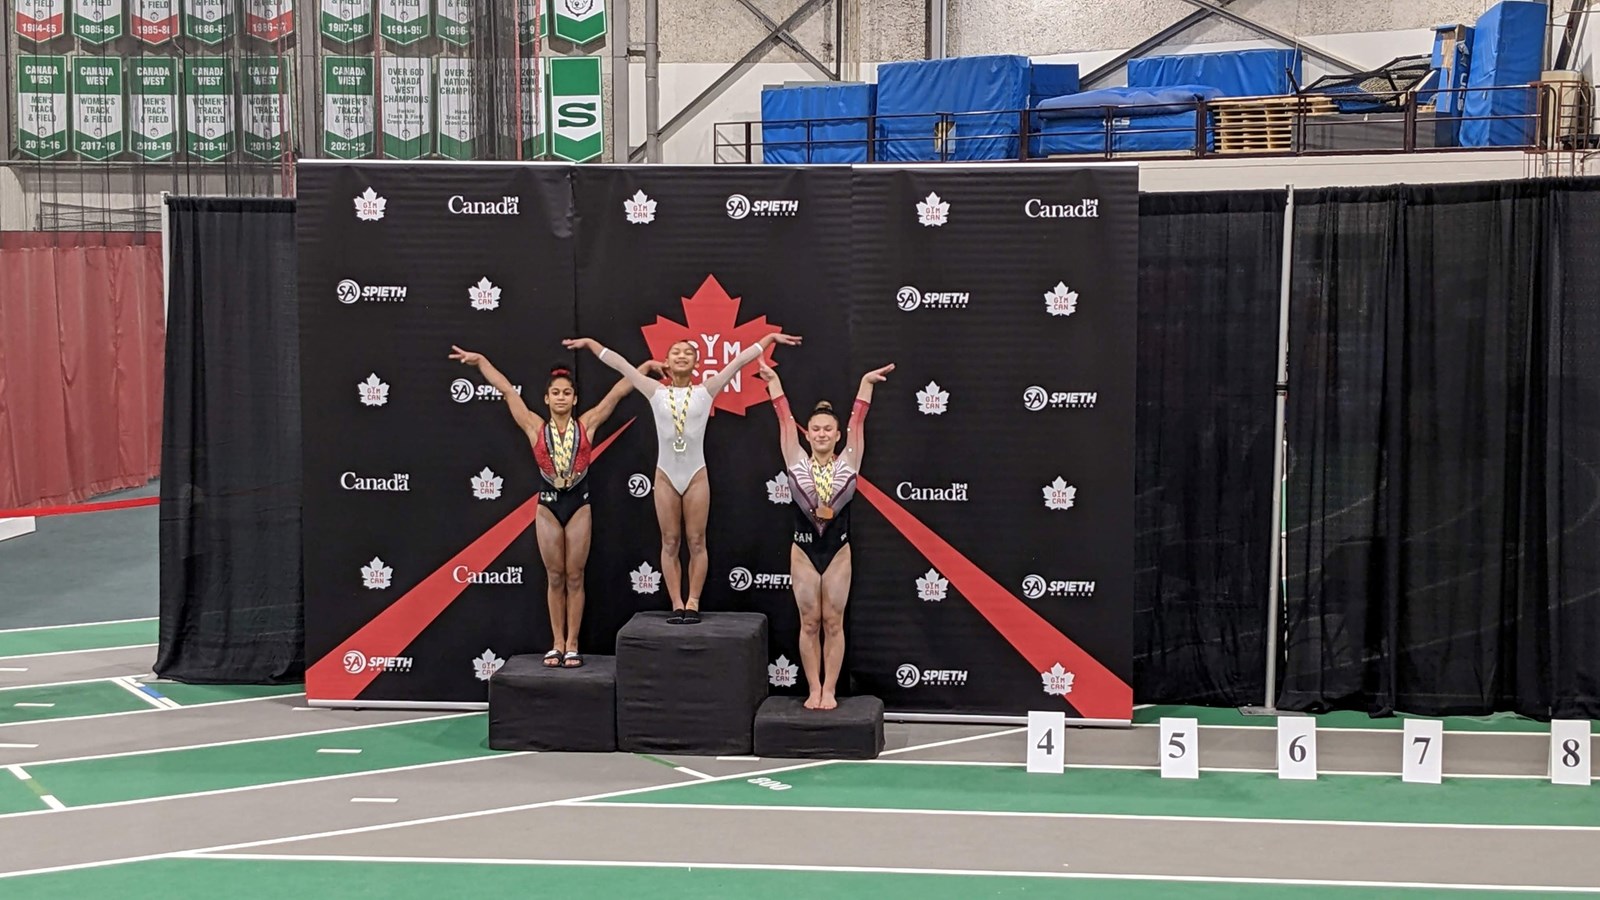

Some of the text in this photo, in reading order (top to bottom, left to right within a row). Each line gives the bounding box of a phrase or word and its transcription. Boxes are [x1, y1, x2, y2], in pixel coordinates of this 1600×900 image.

[80, 24, 115, 34] 1985-86
[136, 67, 170, 76] CANADA
[332, 66, 367, 76] CANADA
[86, 76, 109, 85] WEST
[142, 76, 165, 85] WEST
[198, 76, 221, 85] WEST
[338, 76, 362, 86] WEST
[394, 86, 416, 94] WEST
[143, 97, 166, 105] MEN'S
[199, 106, 223, 115] TRACK
[558, 102, 597, 128] S
[83, 115, 89, 123] &
[148, 115, 169, 124] FIELD
[334, 115, 340, 124] &
[363, 200, 378, 208] GYM
[448, 196, 520, 215] Canada
[633, 204, 648, 212] GYM
[751, 200, 799, 212] SPIETH
[1025, 199, 1099, 218] Canada
[926, 206, 940, 214] GYM
[362, 286, 407, 298] SPIETH
[478, 290, 492, 298] GYM
[921, 293, 969, 304] SPIETH
[1054, 295, 1069, 304] GYM
[367, 386, 381, 394] GYM
[926, 394, 940, 402] GYM
[1048, 392, 1097, 404] SPIETH
[341, 472, 410, 491] Canada
[775, 484, 789, 492] GYM
[897, 482, 968, 501] Canada
[1052, 490, 1066, 498] GYM
[794, 530, 813, 543] CAN
[453, 566, 523, 584] Canada
[1048, 581, 1096, 592] SPIETH
[367, 657, 413, 668] SPIETH
[921, 670, 968, 681] SPIETH
[1050, 675, 1065, 683] GYM
[1037, 728, 1055, 755] 4
[1168, 732, 1186, 759] 5
[1289, 735, 1307, 762] 6
[1413, 737, 1431, 765] 7
[1562, 739, 1581, 767] 8
